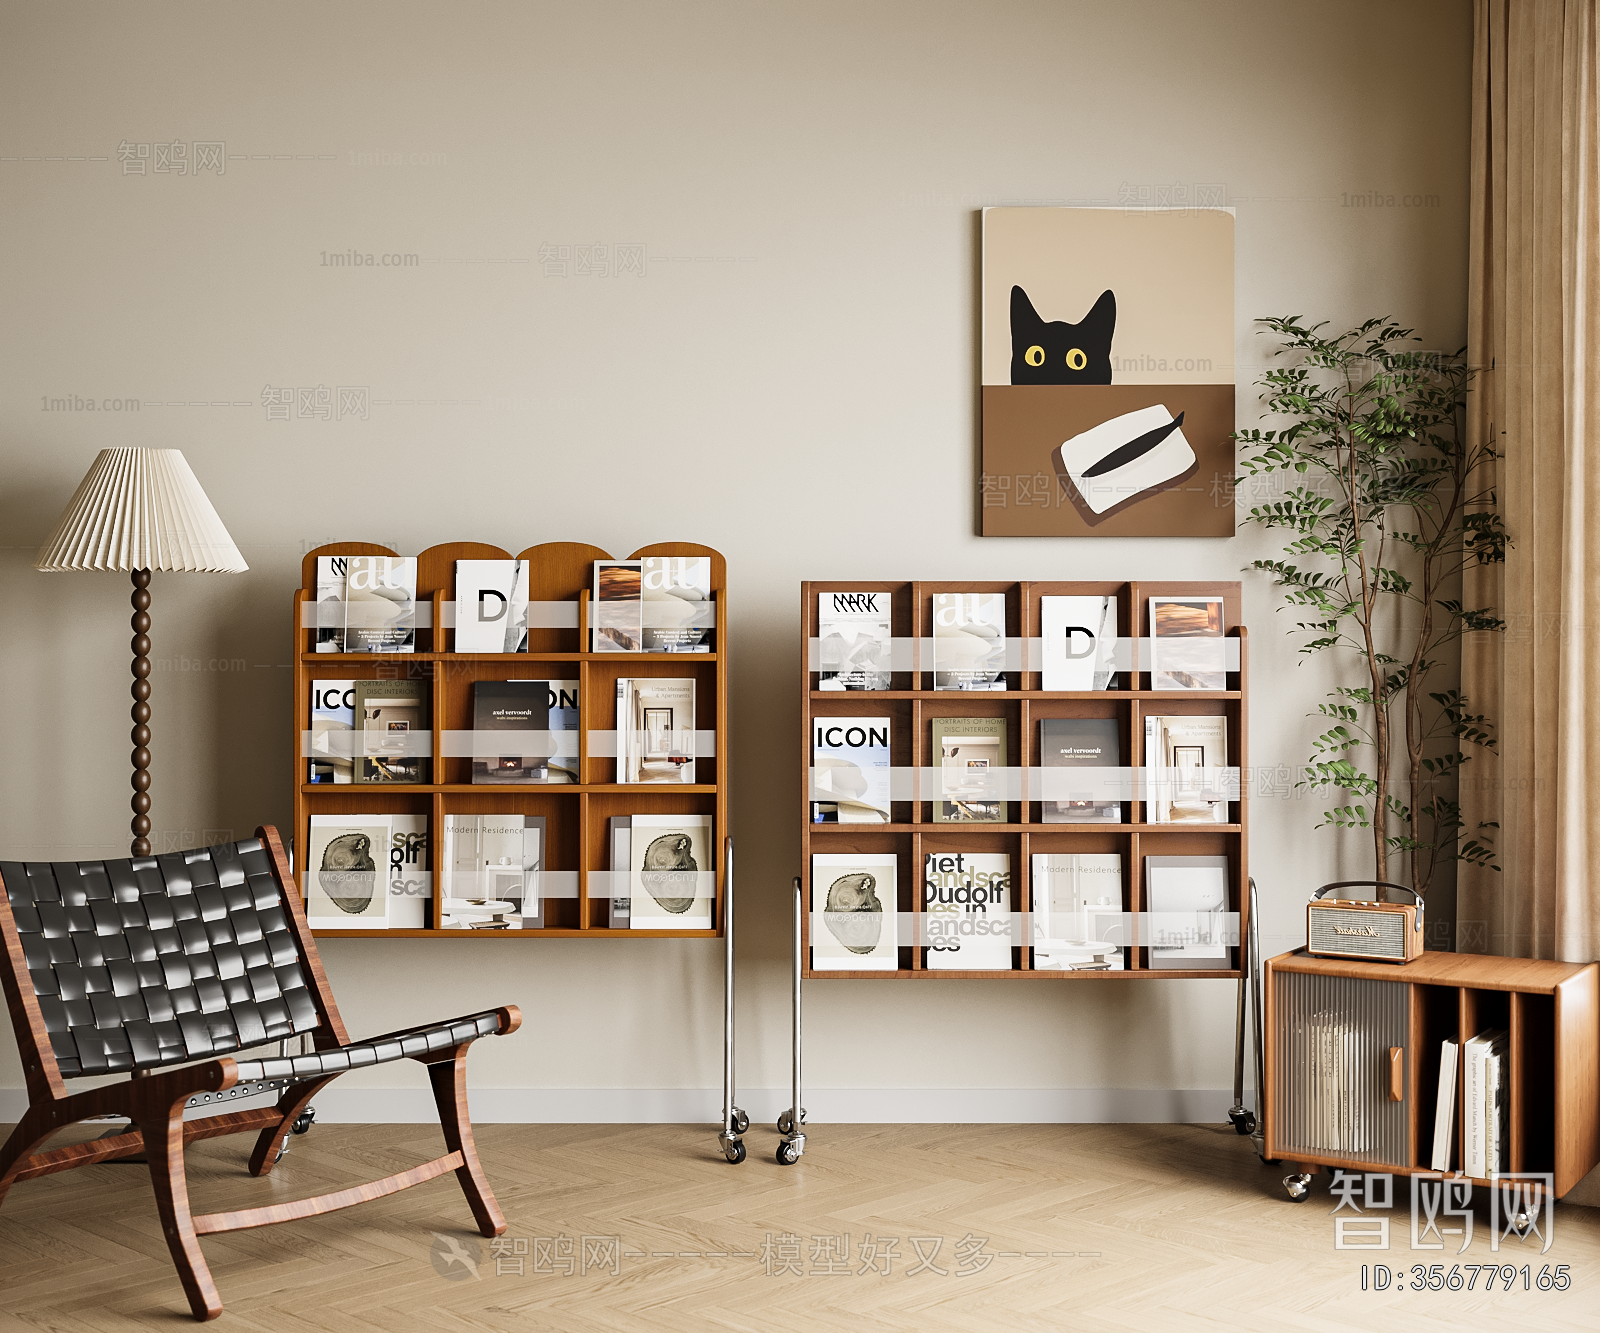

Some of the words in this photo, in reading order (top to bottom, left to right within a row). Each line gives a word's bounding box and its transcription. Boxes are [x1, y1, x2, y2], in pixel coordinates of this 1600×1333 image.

[478, 590, 508, 622] D
[833, 593, 879, 613] MARK
[1065, 626, 1096, 660] D
[817, 727, 888, 748] ICON
[446, 826, 478, 834] Modern
[482, 826, 524, 834] Residence
[1078, 866, 1122, 874] Residence
